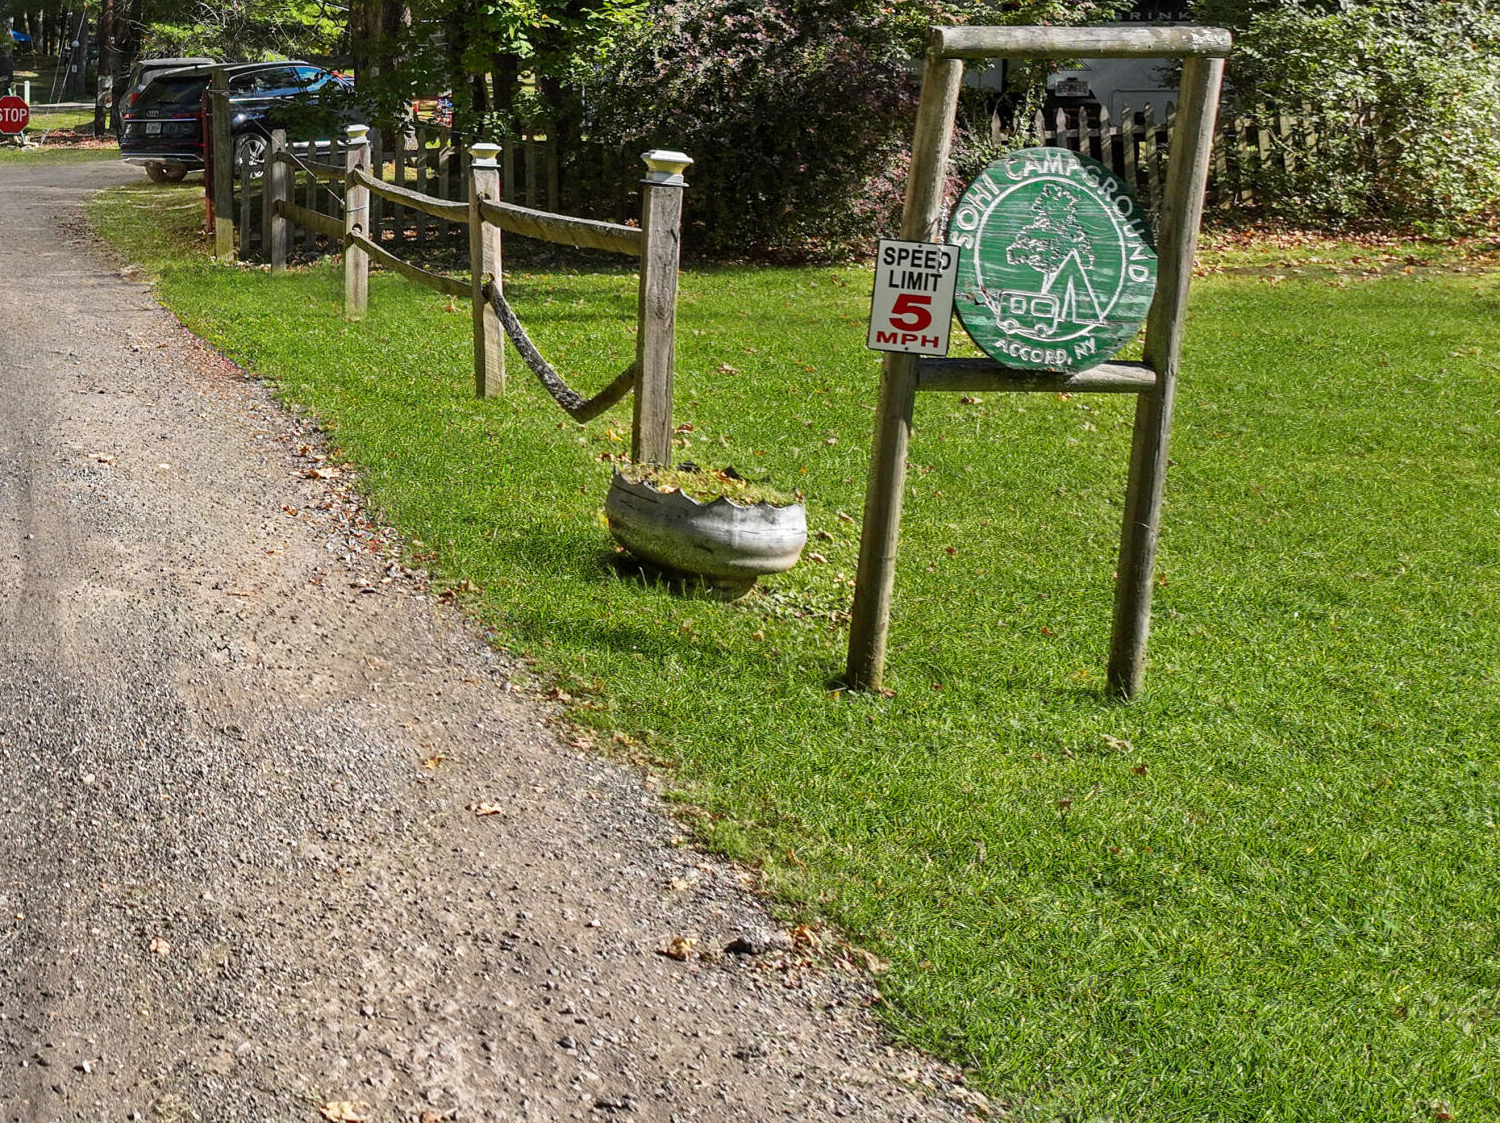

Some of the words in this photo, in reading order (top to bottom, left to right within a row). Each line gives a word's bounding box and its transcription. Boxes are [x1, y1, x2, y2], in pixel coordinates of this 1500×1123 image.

[952, 173, 1001, 250] SOHI
[1004, 150, 1151, 283] CAMPGROUND
[882, 246, 952, 272] SPEED
[887, 270, 944, 293] LIMIT
[888, 293, 933, 332] 5
[875, 330, 941, 349] MPH
[994, 338, 1073, 366] ACCORD,
[1075, 336, 1098, 360] NY
